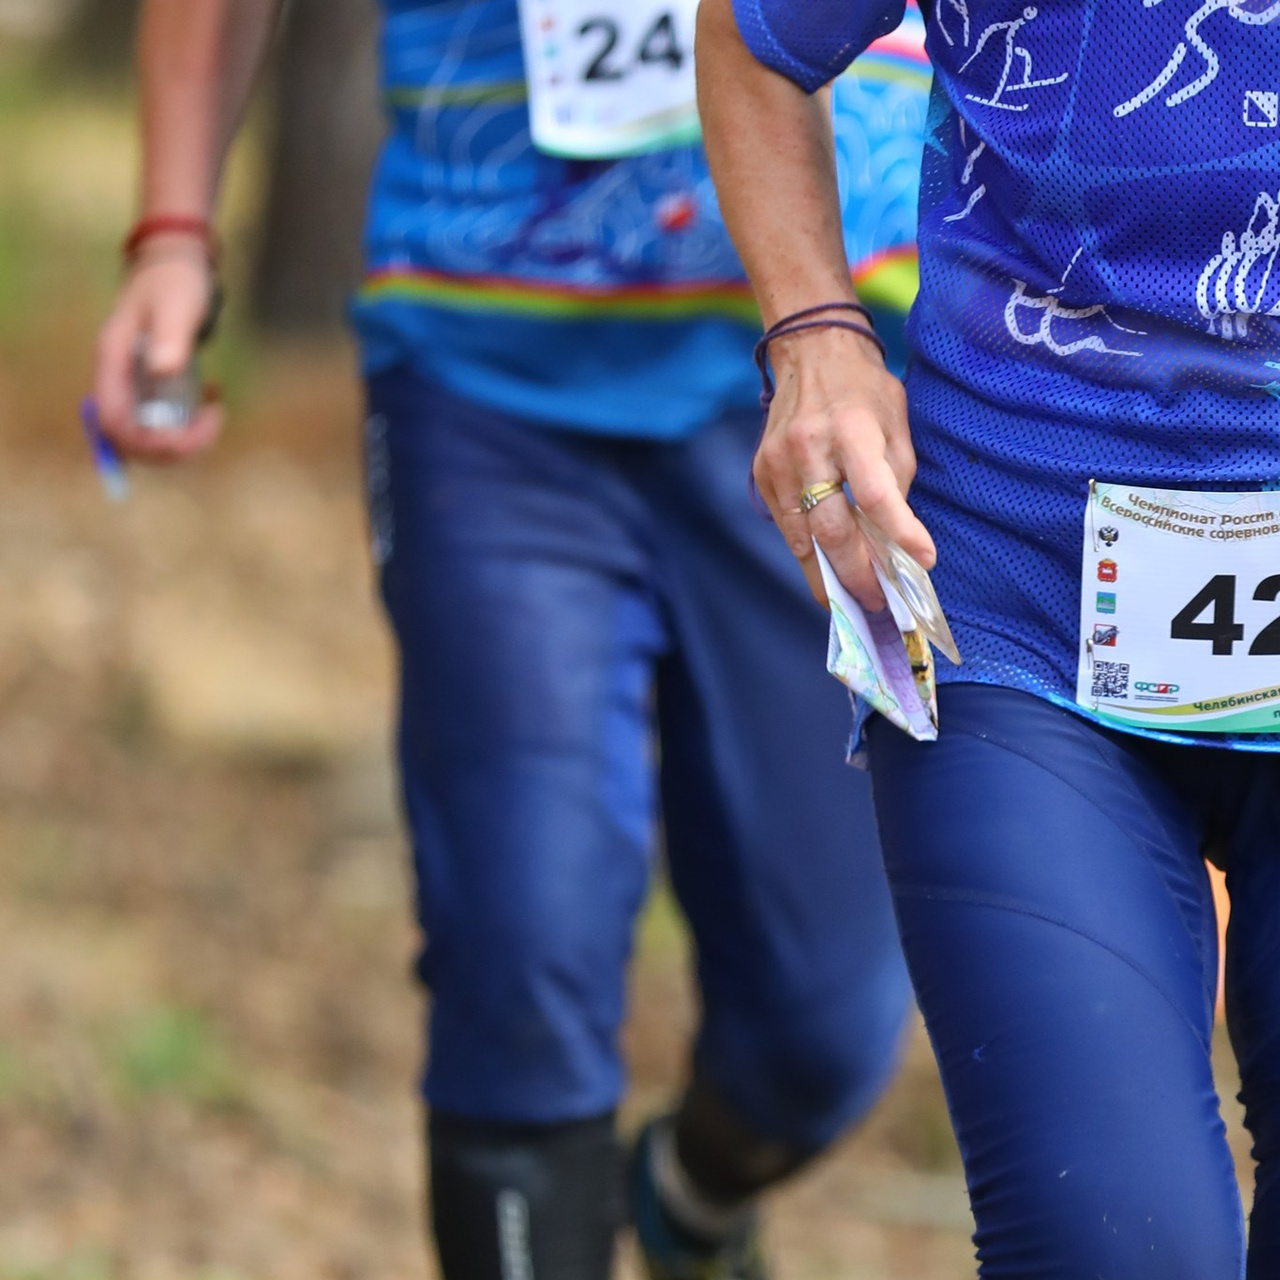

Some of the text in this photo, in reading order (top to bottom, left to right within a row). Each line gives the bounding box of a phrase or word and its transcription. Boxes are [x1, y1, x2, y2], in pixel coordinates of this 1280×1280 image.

[577, 11, 684, 82] 24
[1100, 496, 1205, 537] Всероссийские
[1128, 493, 1216, 524] Чемпионат
[1221, 510, 1274, 525] России
